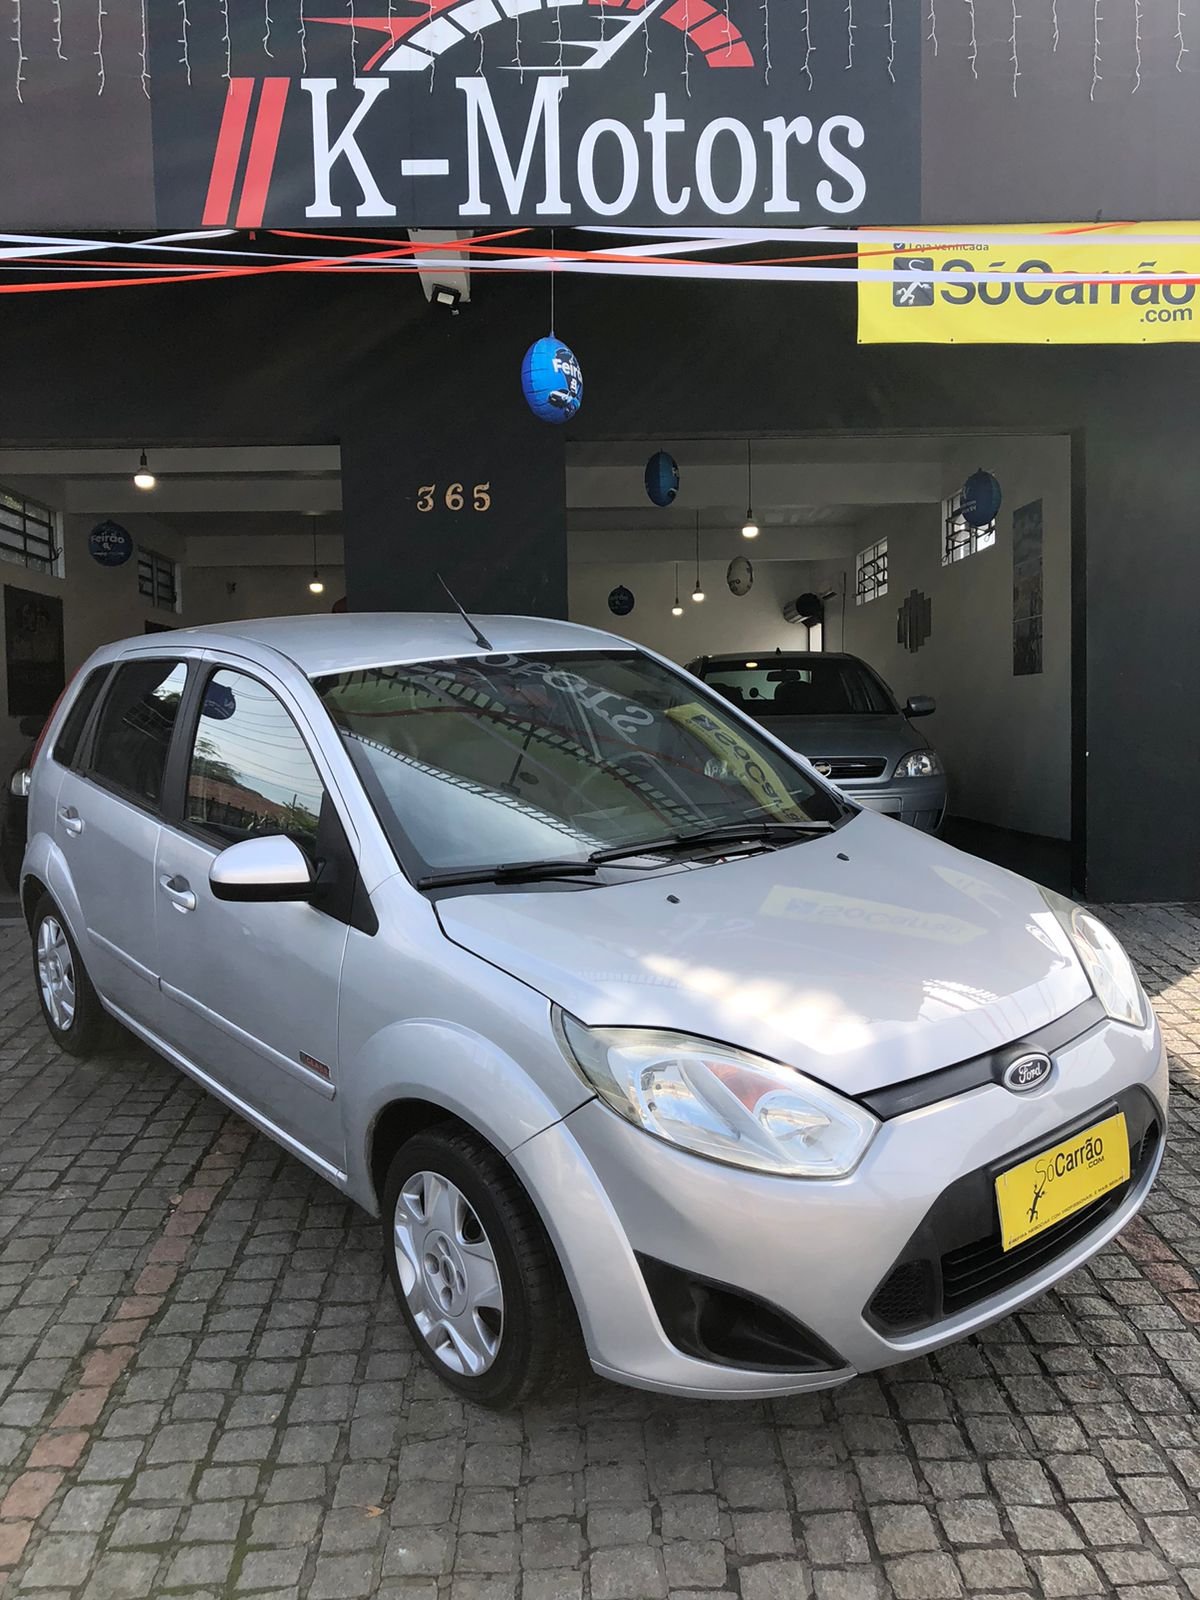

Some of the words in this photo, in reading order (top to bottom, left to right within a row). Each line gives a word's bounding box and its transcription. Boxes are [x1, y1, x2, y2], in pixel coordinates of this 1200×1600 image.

[301, 76, 866, 217] K-Motors
[941, 259, 1196, 305] SóCarrão
[416, 481, 491, 512] 365
[1018, 1061, 1042, 1084] Ford
